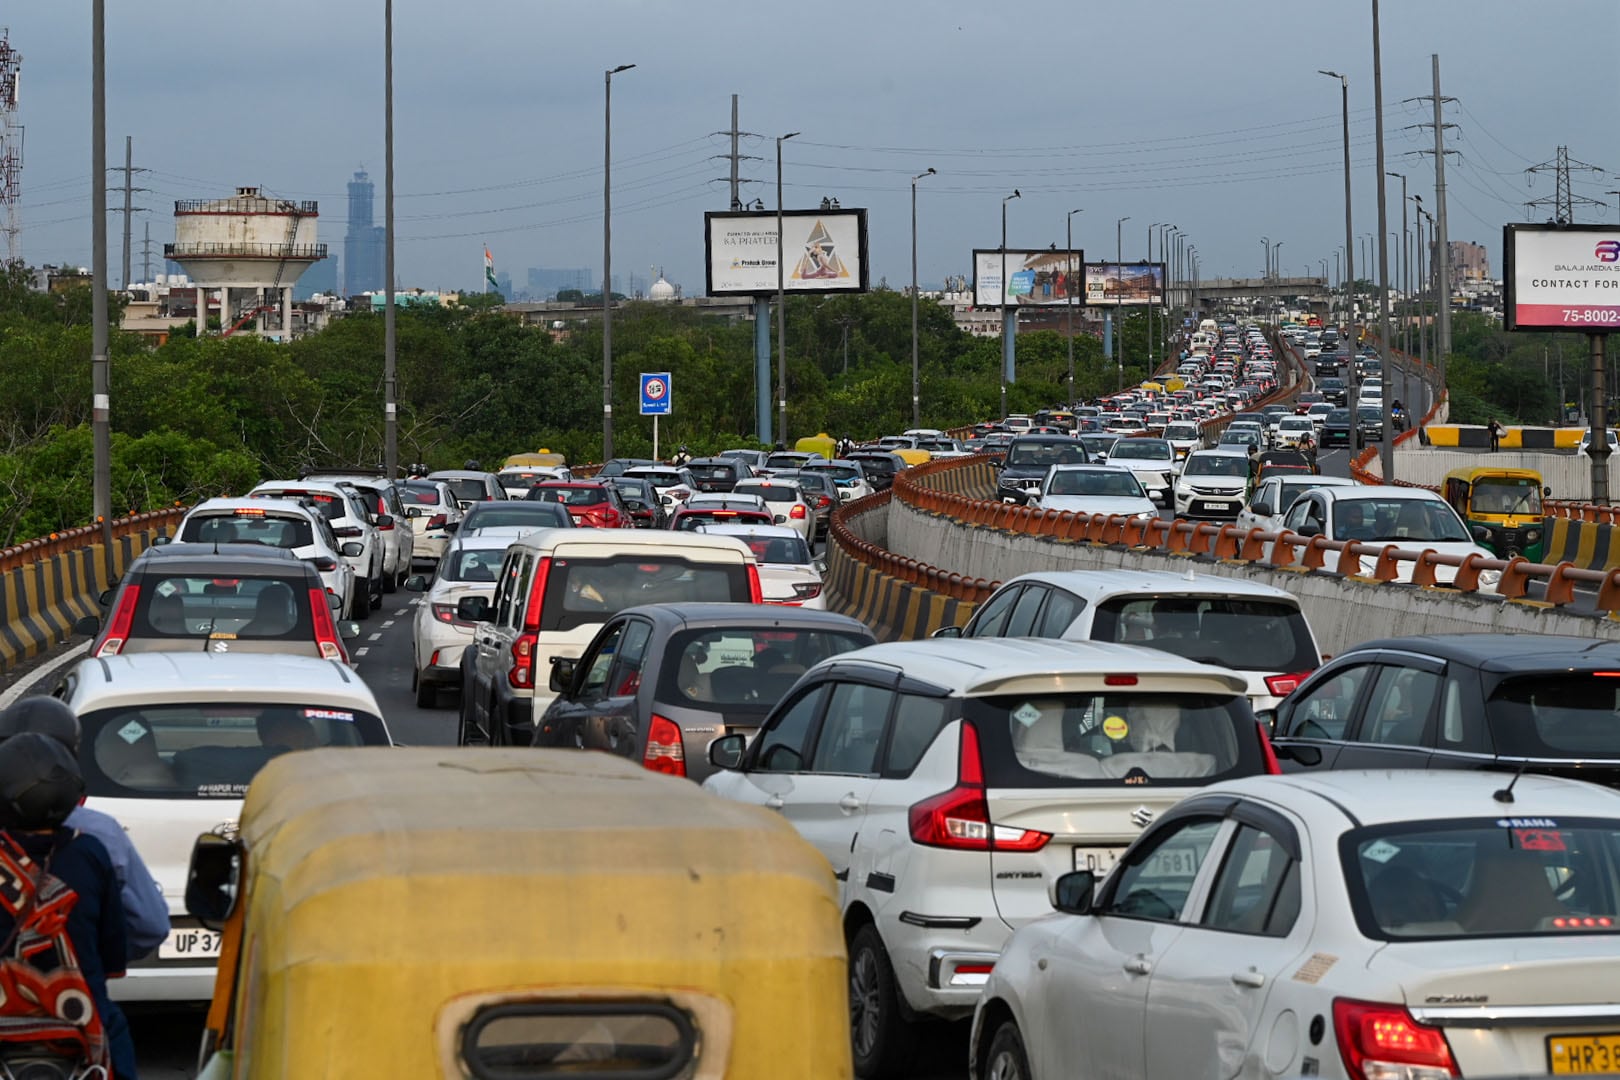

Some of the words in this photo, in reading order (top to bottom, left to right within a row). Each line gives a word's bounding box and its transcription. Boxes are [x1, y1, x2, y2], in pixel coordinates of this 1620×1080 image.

[739, 236, 778, 245] PRATEE
[1532, 279, 1589, 288] CONTACT
[1594, 280, 1619, 289] FOR
[304, 708, 354, 722] POLICE
[208, 784, 232, 792] HAPUR
[1087, 854, 1106, 872] DL
[176, 934, 198, 953] UP
